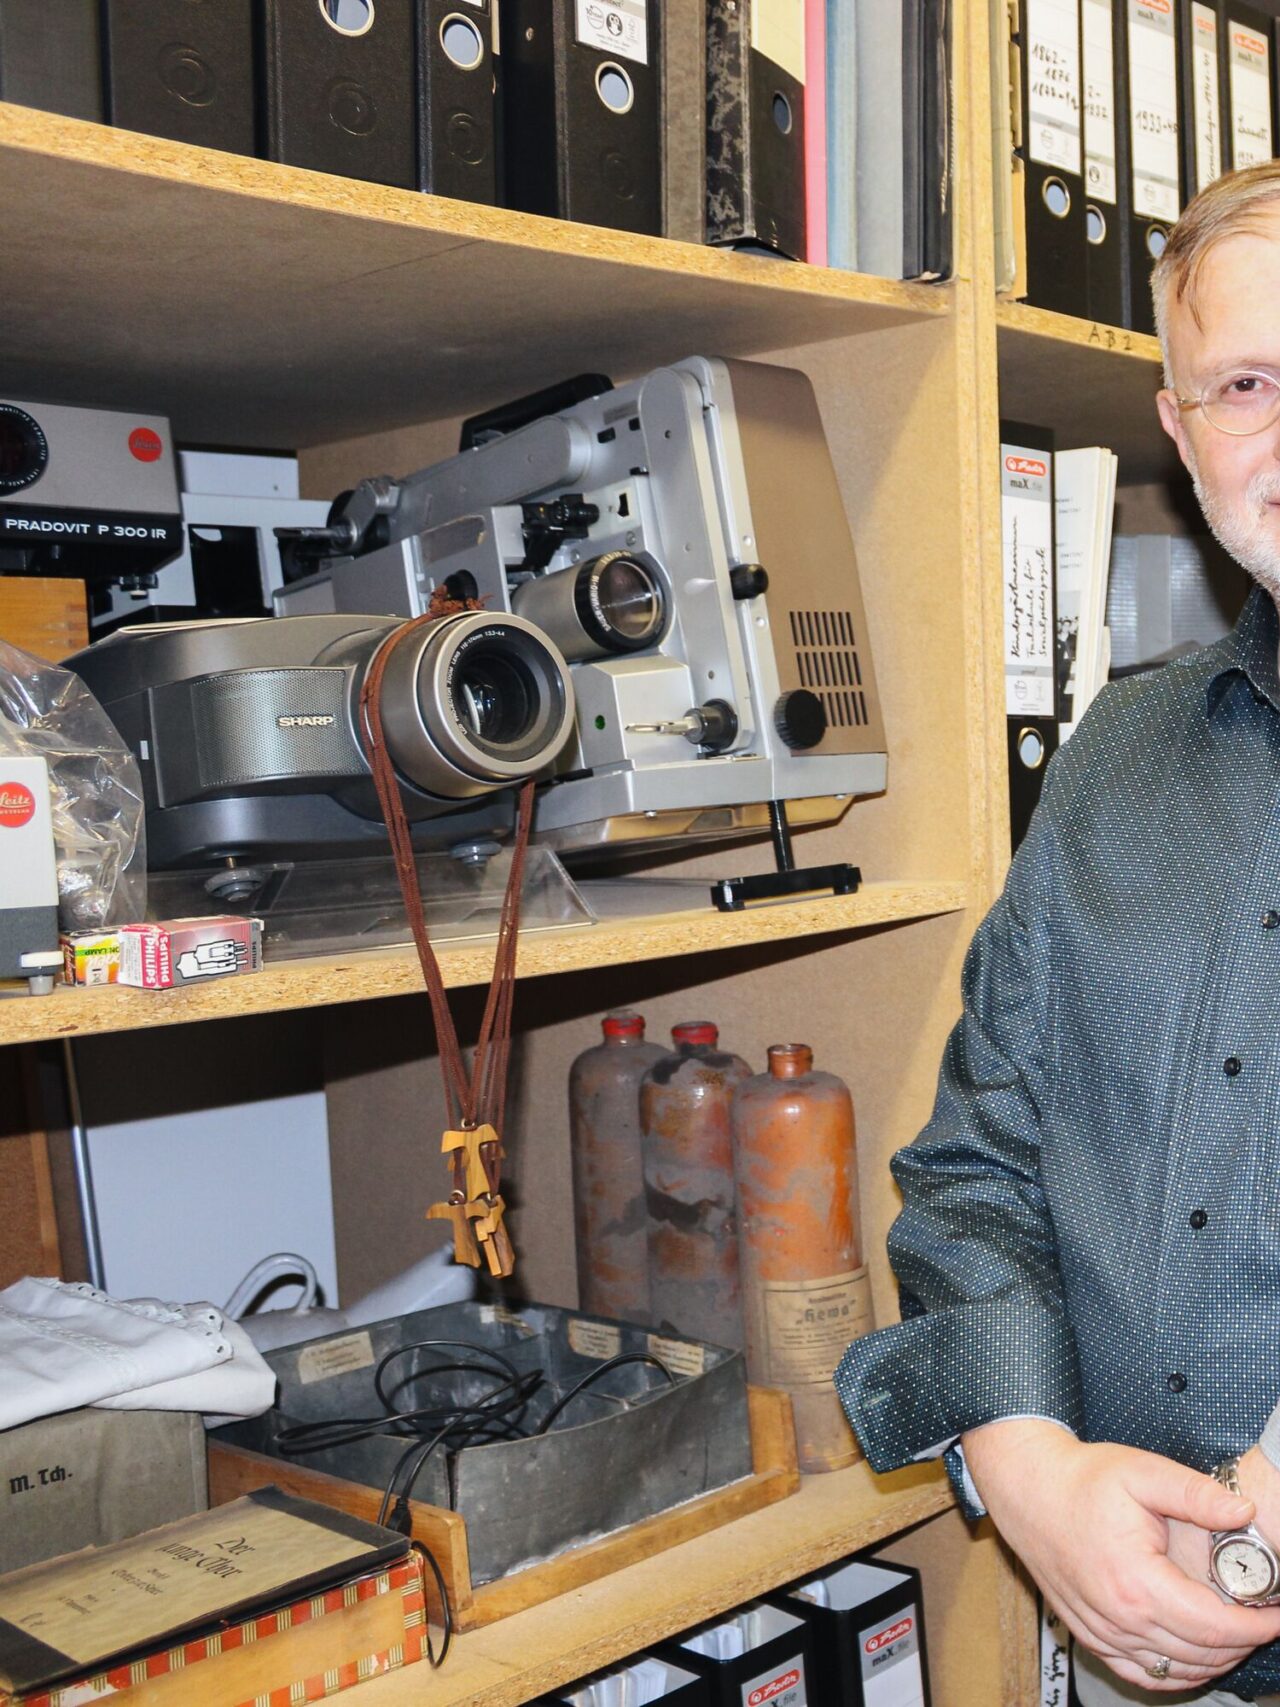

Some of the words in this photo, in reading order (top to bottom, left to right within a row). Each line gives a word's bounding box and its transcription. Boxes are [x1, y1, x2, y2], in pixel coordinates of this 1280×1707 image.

[5, 518, 91, 535] PRADOVIT
[97, 524, 109, 535] P
[114, 527, 148, 538] 300
[151, 528, 166, 539] IR
[279, 716, 334, 727] SHARP
[145, 935, 156, 984] PHILIPS
[159, 936, 169, 983] PHILIPS
[214, 1536, 256, 1556] Der
